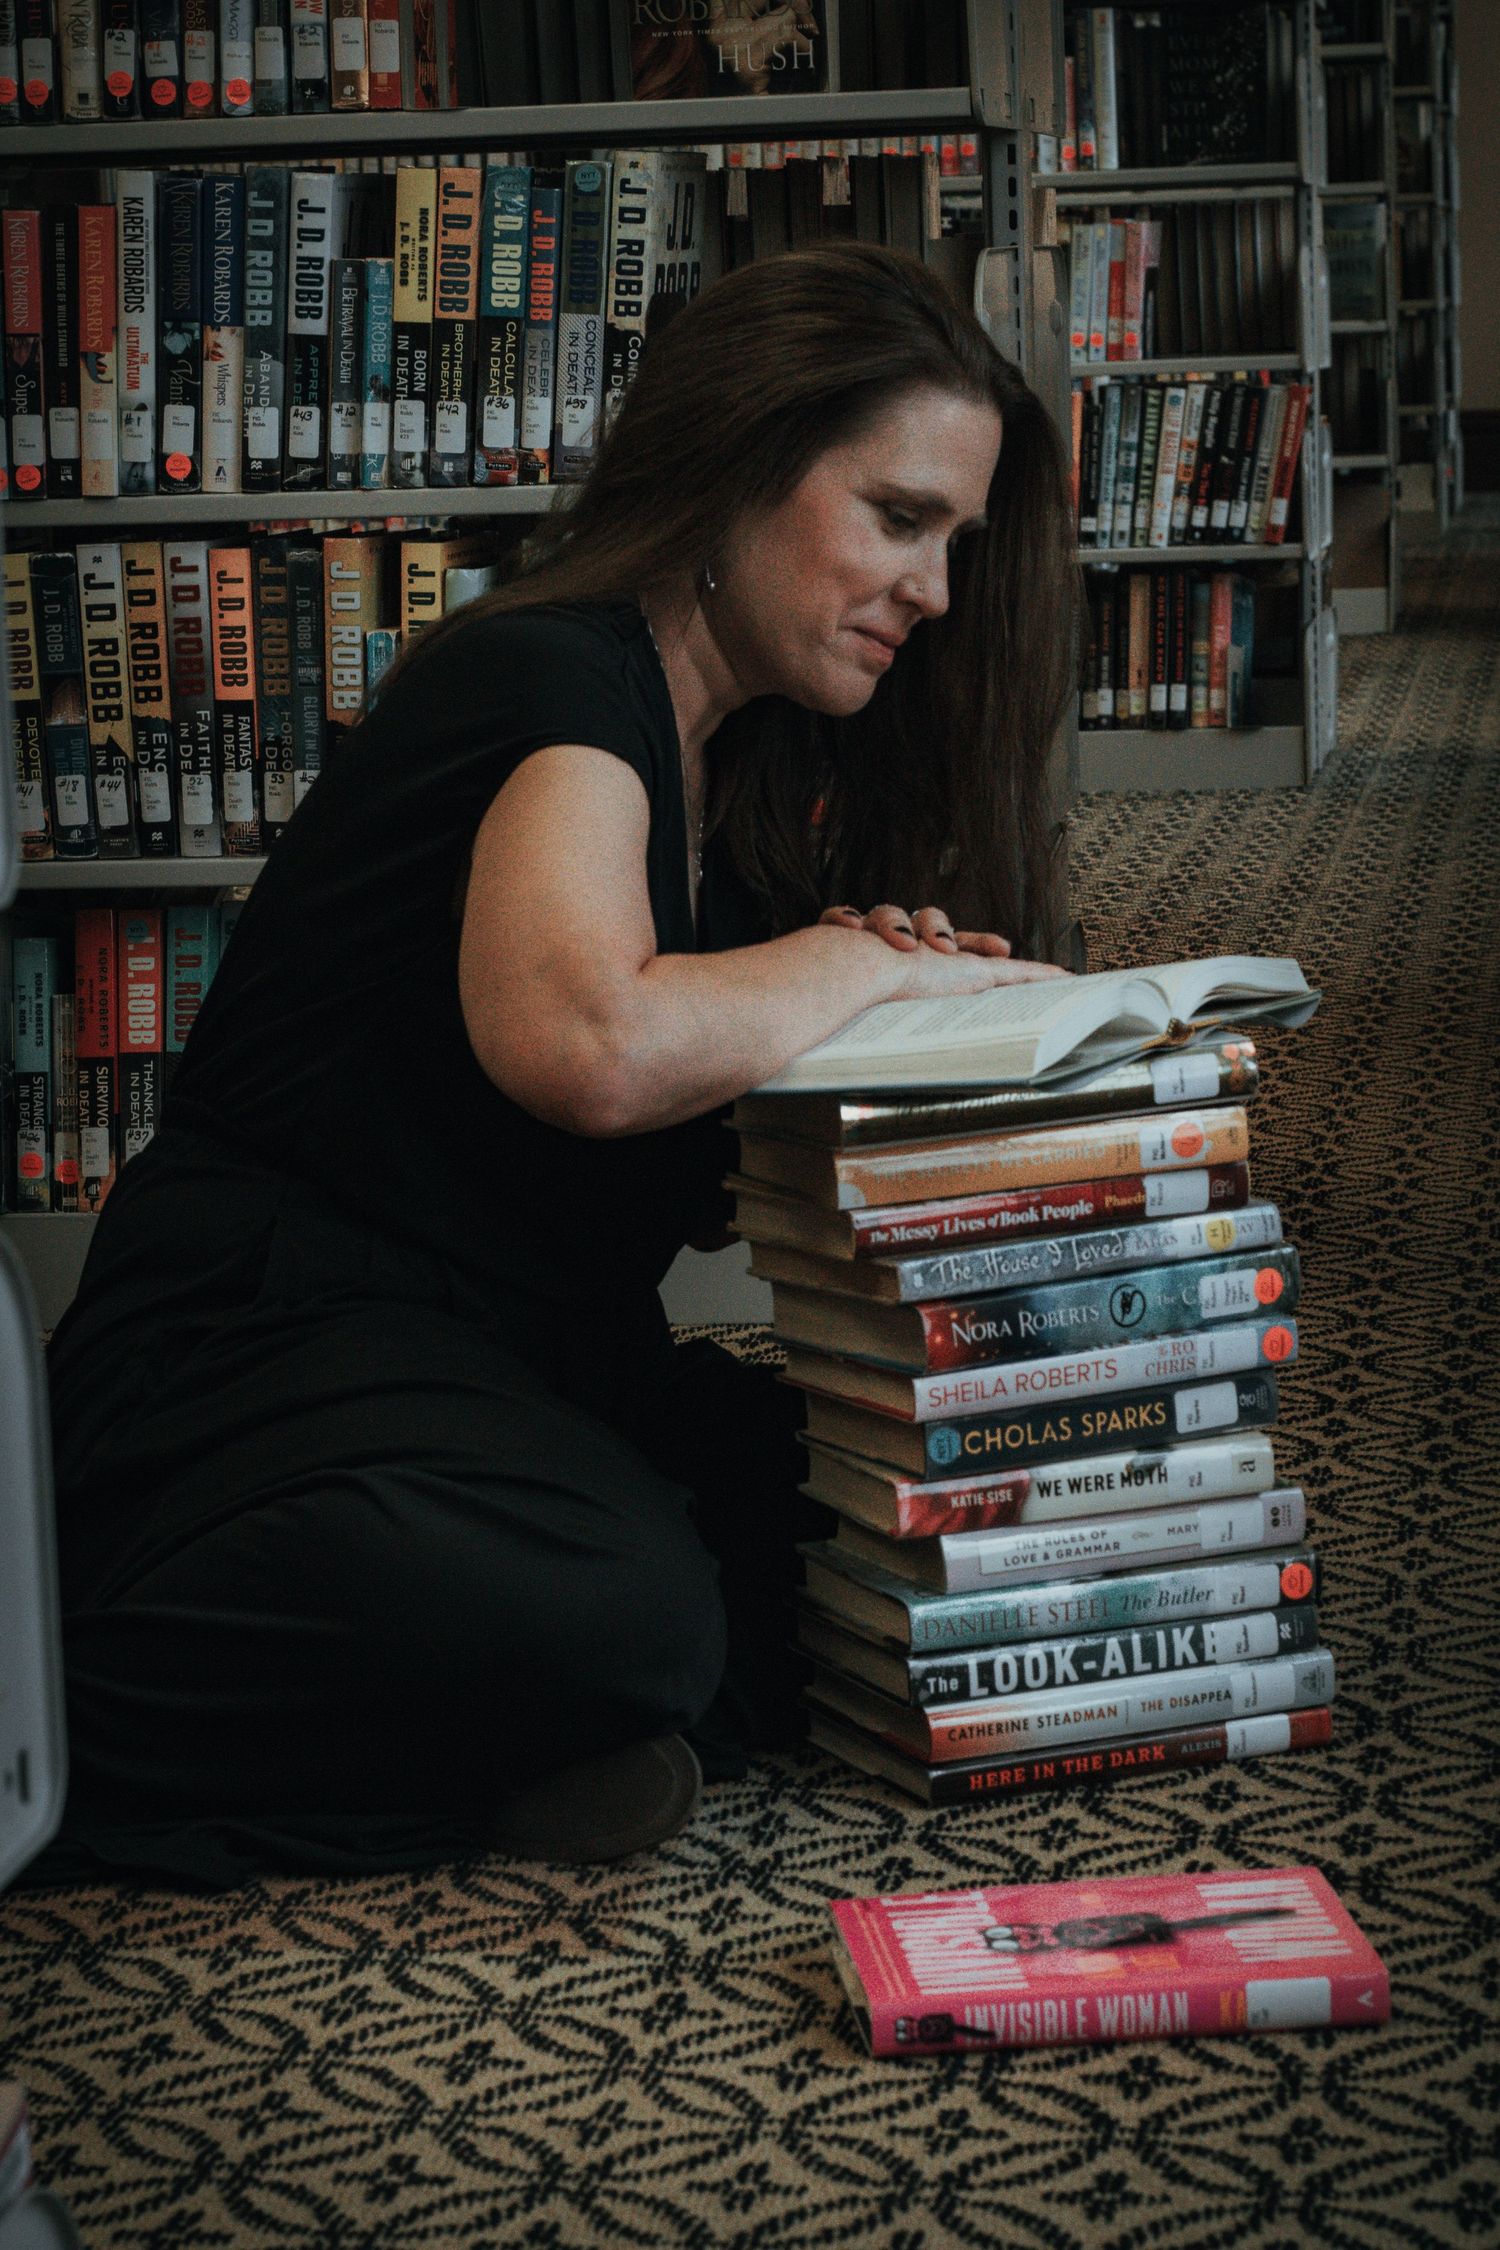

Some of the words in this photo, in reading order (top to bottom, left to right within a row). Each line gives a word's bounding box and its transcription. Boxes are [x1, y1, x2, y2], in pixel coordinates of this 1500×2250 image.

[672, 28, 693, 36] YORK
[717, 39, 816, 73] HUSH
[581, 171, 600, 180] NYT
[123, 197, 144, 244] KAREN
[171, 191, 196, 238] KAREN
[214, 182, 235, 241] KAREN
[418, 207, 429, 242] NORA
[8, 218, 30, 263] KAREN
[85, 217, 103, 271] KAREN
[123, 248, 145, 314] ROBARDS
[170, 243, 194, 311] ROBARDS
[213, 245, 235, 323] ROBARDS
[245, 249, 275, 327] ROBB
[294, 256, 324, 320] ROBB
[399, 253, 410, 288] ROBB
[417, 246, 428, 302] ROBERTS
[438, 244, 472, 312] ROBB
[490, 243, 523, 309] ROBB
[529, 262, 556, 321] ROBB
[569, 239, 600, 305] ROBB
[614, 238, 645, 318] ROBB
[11, 265, 29, 327] ROBARDS
[86, 275, 105, 348] ROBARDS
[339, 287, 358, 338] BETRAYAL
[126, 326, 140, 391] ULTIMATUM
[140, 352, 149, 366] THE
[342, 340, 353, 350] IN
[370, 319, 388, 363] ROBB
[397, 335, 409, 352] IN
[442, 343, 451, 359] IN
[490, 336, 501, 353] IN
[503, 321, 517, 397] CALCULA
[527, 345, 538, 359] IN
[569, 331, 579, 347] IN
[584, 319, 601, 396] CONCEAL
[612, 353, 624, 369] IN
[217, 363, 233, 407] Whispers
[339, 352, 355, 384] DEATH
[413, 349, 428, 392] BORN
[489, 356, 501, 396] DEAT
[539, 338, 551, 398] CELEBR
[486, 398, 510, 410] #36
[45, 623, 65, 664] ROBB
[296, 616, 313, 650] ROBB
[6, 628, 35, 690] ROBB
[129, 622, 163, 704] ROBB
[173, 616, 207, 697] ROBB
[218, 625, 249, 688] ROBB
[260, 616, 292, 697] ROBB
[330, 625, 364, 711] ROBB
[87, 637, 124, 724] ROBB
[137, 731, 147, 745] IN
[179, 722, 190, 738] IN
[222, 713, 234, 729] IN
[265, 726, 275, 742] IN
[302, 695, 322, 736] GLORY
[26, 716, 42, 783] DEVOTE
[95, 749, 107, 767] IN
[195, 710, 212, 770] FAITH
[237, 715, 253, 774] FANTASY
[280, 711, 294, 771] FORGO
[34, 972, 44, 1000] NORA
[98, 947, 110, 983] NORA
[34, 1002, 45, 1048] ROBERTS
[98, 989, 111, 1049] ROBERTS
[127, 983, 157, 1045] ROBB
[19, 1085, 31, 1101] IN
[78, 1070, 90, 1085] IN
[96, 1065, 111, 1129] SURVIVO
[129, 1072, 140, 1088] IN
[144, 1060, 155, 1132] THANKLE
[127, 1131, 151, 1143] #37
[869, 1229, 889, 1244] The
[889, 1224, 940, 1242] Messy
[944, 1213, 987, 1236] Lives
[987, 1211, 1000, 1229] of
[999, 1205, 1041, 1231] Book
[1042, 1200, 1095, 1225] People
[930, 1254, 974, 1286] The
[981, 1248, 1041, 1281] House
[1072, 1228, 1124, 1274] Loved
[949, 1314, 1013, 1349] NORA
[1017, 1306, 1101, 1339] ROBERTS
[928, 1377, 1009, 1408] SHEILA
[1014, 1359, 1119, 1394] ROBERTS
[1145, 1355, 1198, 1377] CHRIS
[964, 1416, 1074, 1456] CHOLAS
[1080, 1401, 1168, 1438] SPARKS
[951, 1493, 986, 1509] KATIE
[986, 1488, 1015, 1506] SISE
[1037, 1481, 1063, 1500] WE
[1067, 1472, 1116, 1495] WERE
[1120, 1466, 1169, 1489] MOTH
[1090, 1527, 1109, 1541] OF
[1166, 1523, 1199, 1537] MARY
[1003, 1553, 1037, 1569] LOVE
[1042, 1552, 1051, 1563] &
[1056, 1540, 1121, 1560] GRAMMAR
[923, 1604, 1041, 1641] DANIELLE
[1047, 1595, 1111, 1626] STEEL
[1122, 1592, 1152, 1613] The
[1156, 1585, 1215, 1610] Butler
[926, 1676, 960, 1695] The
[966, 1621, 1217, 1698] LOOK-ALIKE
[1140, 1699, 1164, 1713] THE
[1169, 1689, 1232, 1709] DISAPPEA
[948, 1719, 1030, 1743] CATHERINE
[1037, 1705, 1118, 1729] STEADMAN
[969, 1770, 1026, 1792] HERE
[1034, 1763, 1056, 1781] IN
[1061, 1754, 1103, 1775] THE
[1109, 1743, 1167, 1769] DARK
[964, 1997, 1090, 2047] INVISIBLE
[1095, 1990, 1191, 2038] WOMAN
